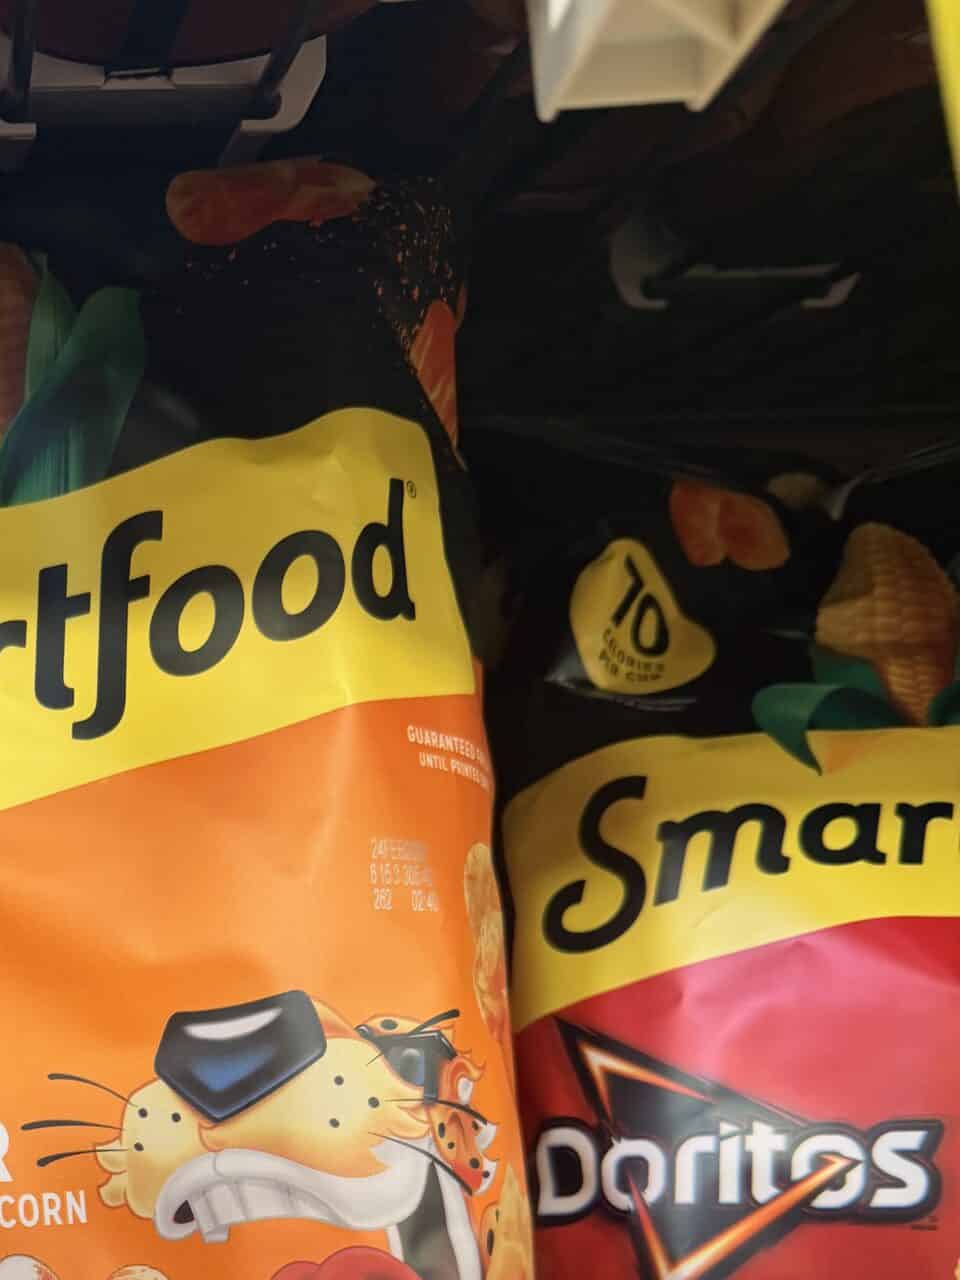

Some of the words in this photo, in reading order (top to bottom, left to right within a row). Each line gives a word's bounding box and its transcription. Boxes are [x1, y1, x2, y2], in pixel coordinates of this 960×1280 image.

[610, 554, 670, 658] 70
[419, 752, 449, 772] UNTIL
[536, 1119, 929, 1216] Doritos
